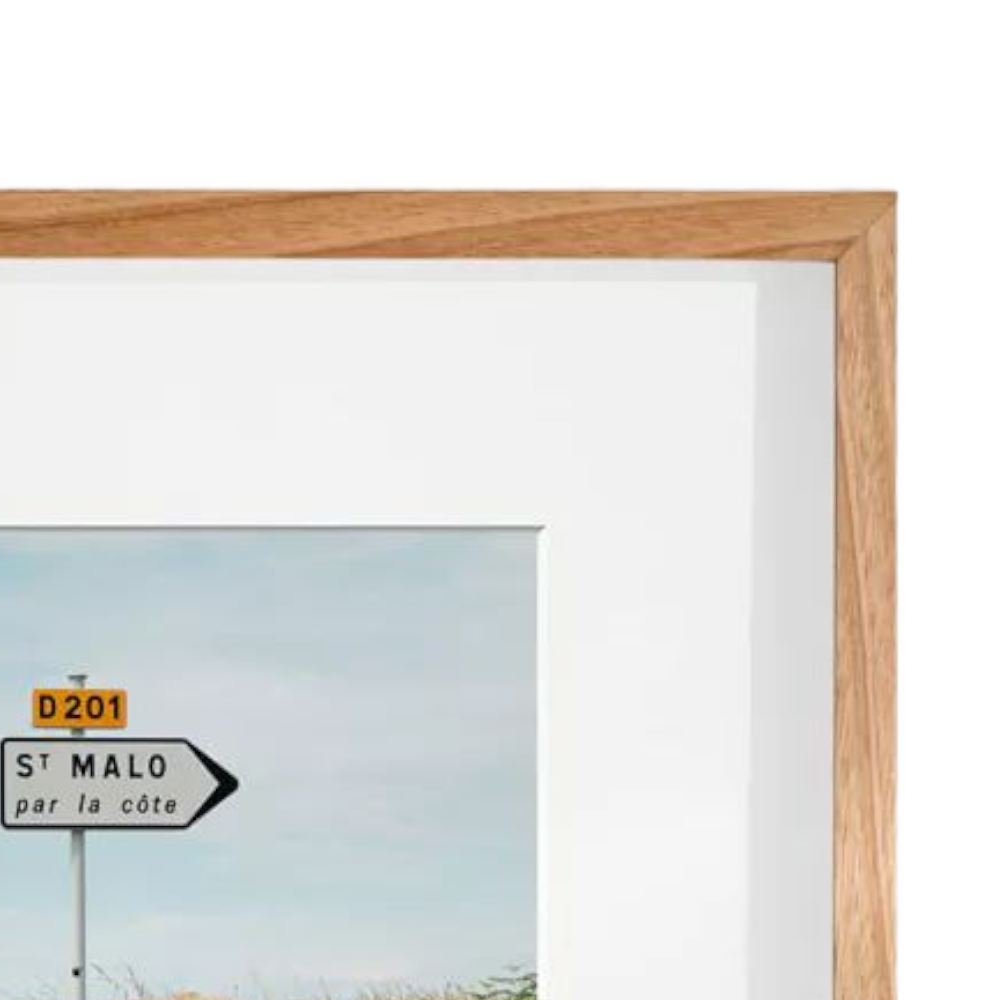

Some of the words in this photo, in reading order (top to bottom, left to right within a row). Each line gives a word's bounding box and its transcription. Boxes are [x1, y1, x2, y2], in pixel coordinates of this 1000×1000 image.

[71, 753, 167, 778] MALO
[15, 799, 58, 818] par
[78, 793, 103, 814] la
[121, 794, 177, 814] côte
